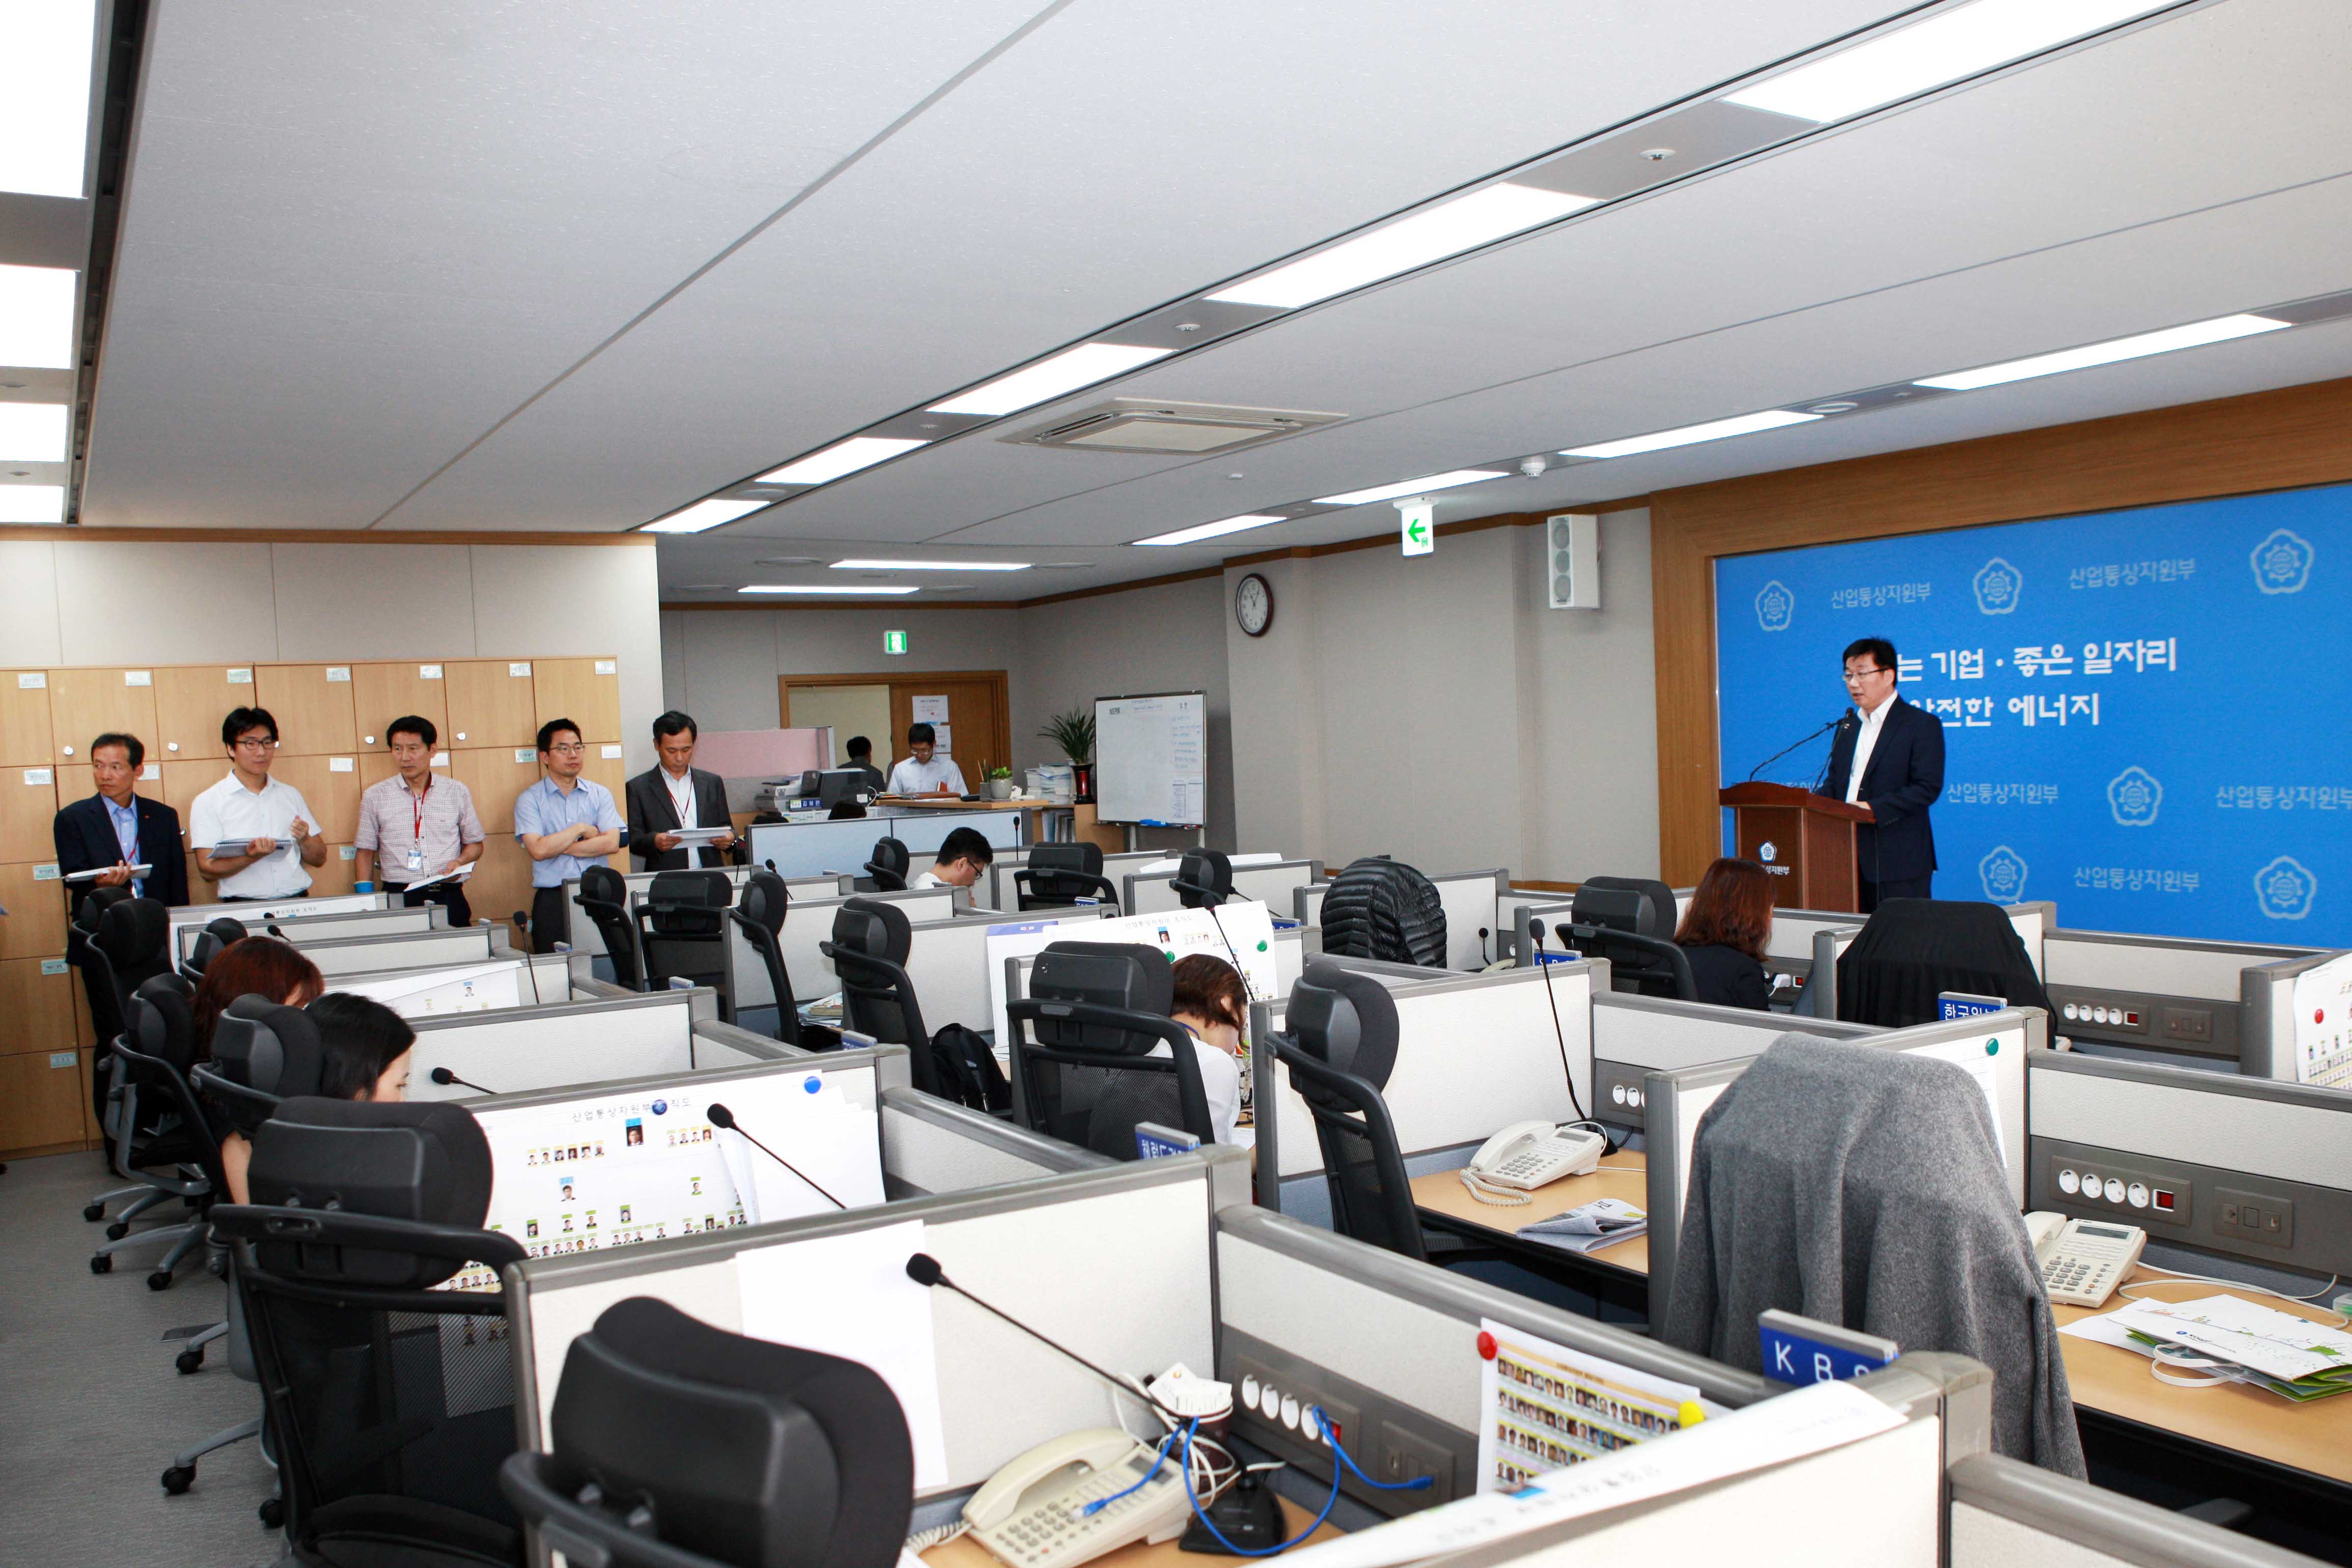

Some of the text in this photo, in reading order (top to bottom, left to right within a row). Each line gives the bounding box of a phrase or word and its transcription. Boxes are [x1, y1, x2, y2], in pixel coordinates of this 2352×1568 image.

[2069, 558, 2196, 589] 산업통상자원부
[1832, 582, 1931, 609] 산업통상자원부
[1931, 648, 1984, 680] 기업
[2013, 644, 2074, 677] 좋은
[2083, 637, 2176, 674] 일자리
[2008, 692, 2099, 726] 에너지
[1947, 783, 2059, 804] 산업통상자원부
[2217, 786, 2352, 809] 산업통상자원부
[2075, 866, 2200, 892] 산업통상자원부
[573, 1098, 692, 1122] 산업통상자원부 직도
